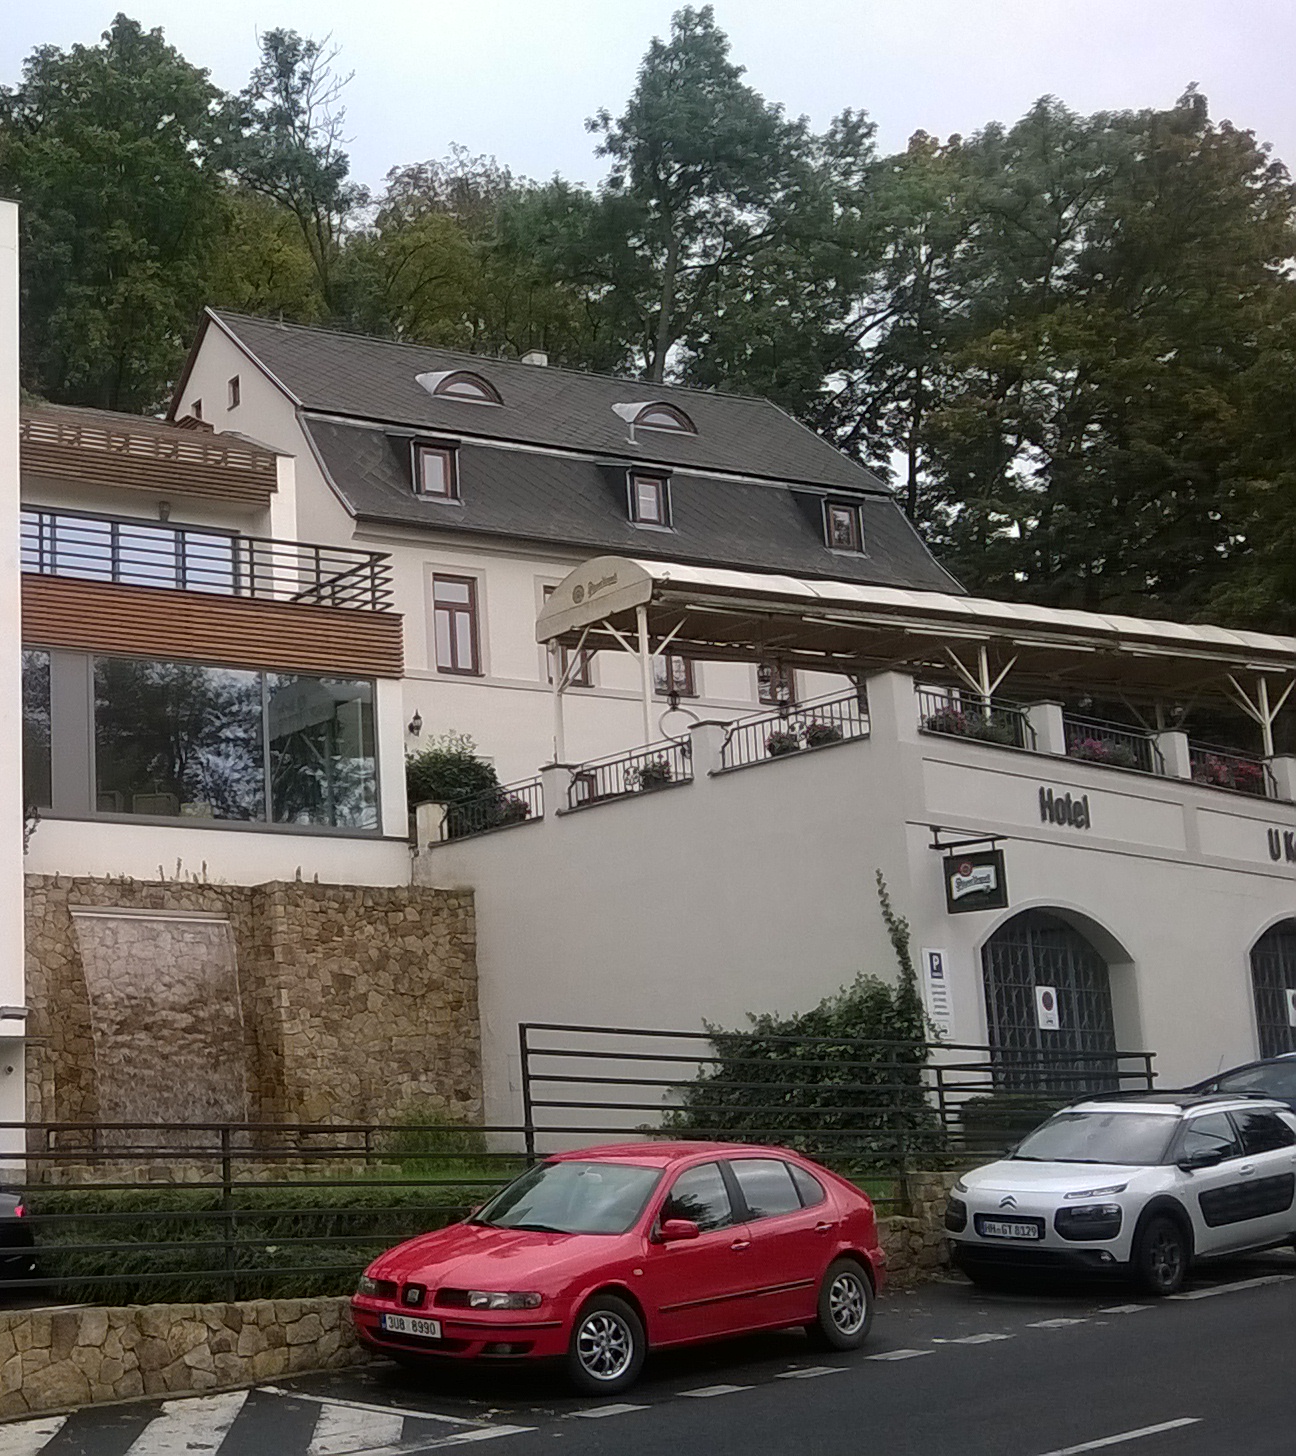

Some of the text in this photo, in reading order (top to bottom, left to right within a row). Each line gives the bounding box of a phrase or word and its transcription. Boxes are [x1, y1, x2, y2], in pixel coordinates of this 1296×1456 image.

[1039, 786, 1091, 830] Hotel
[1268, 828, 1296, 864] U K
[932, 954, 940, 971] P
[411, 1319, 436, 1336] 8990
